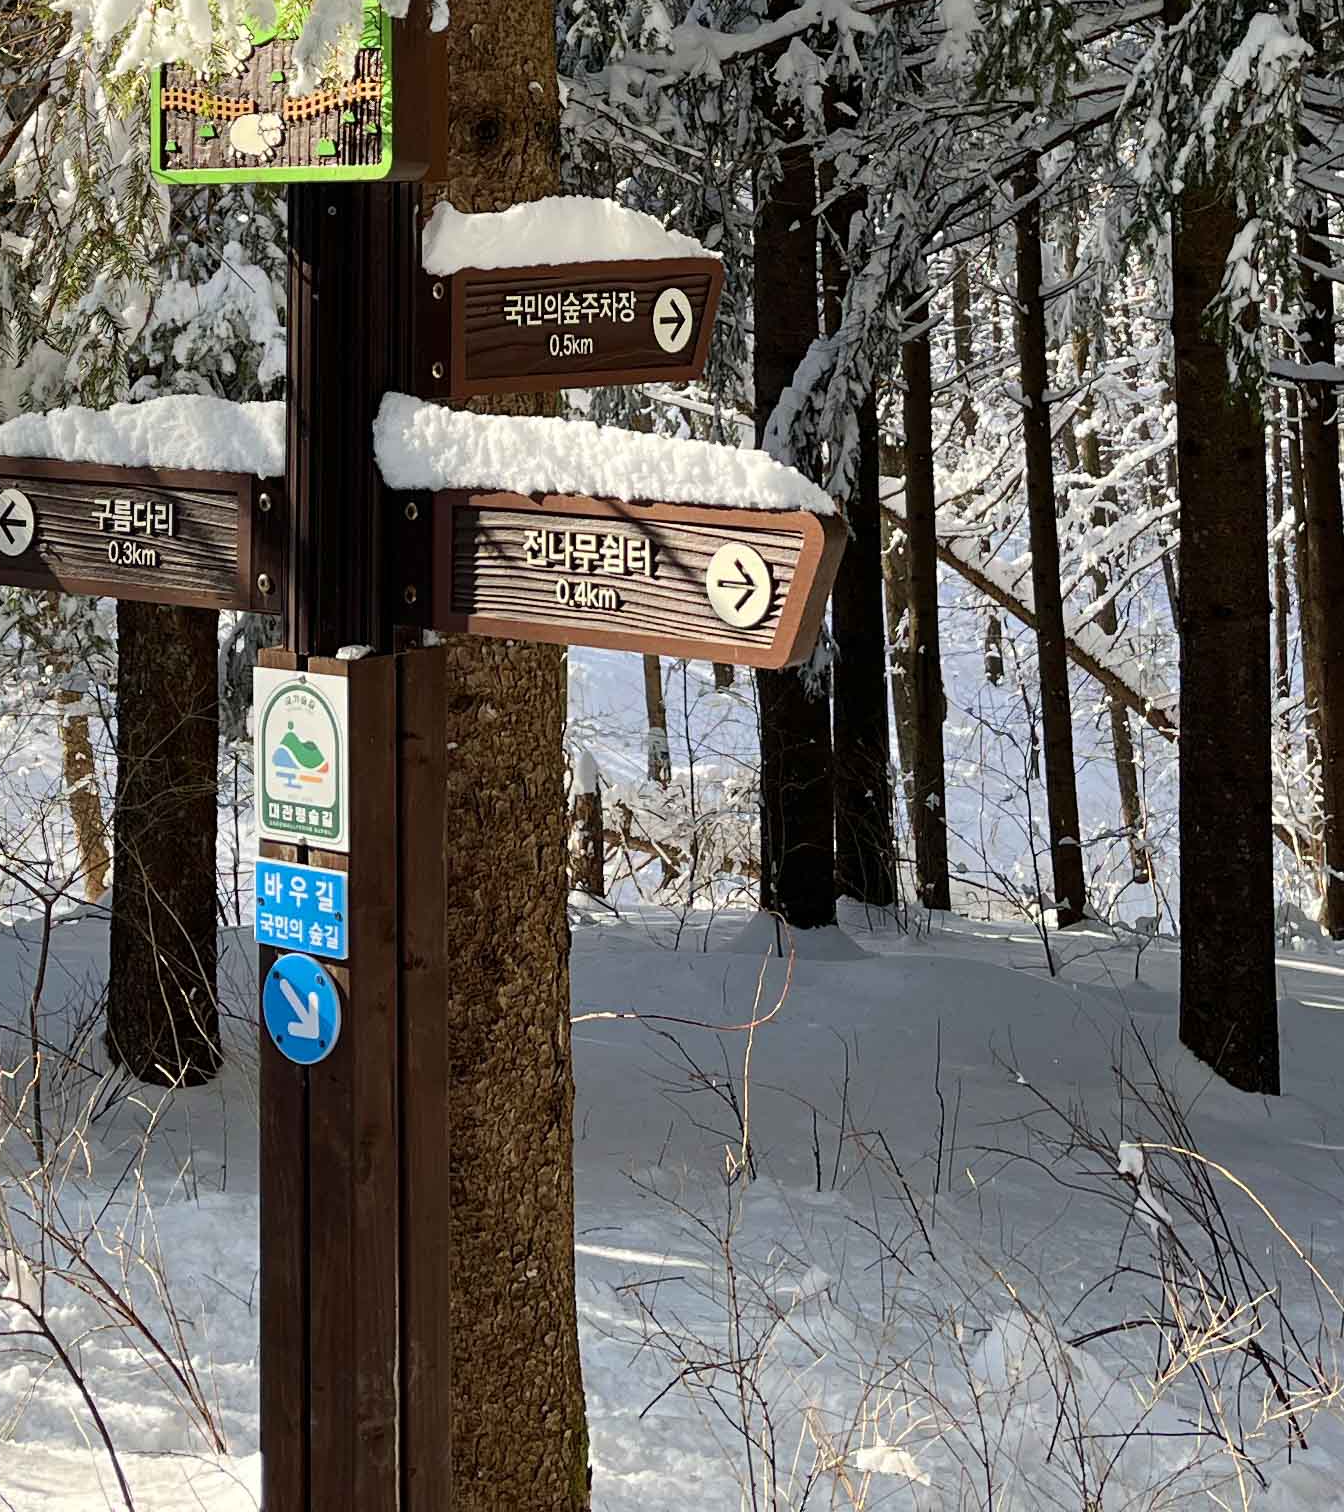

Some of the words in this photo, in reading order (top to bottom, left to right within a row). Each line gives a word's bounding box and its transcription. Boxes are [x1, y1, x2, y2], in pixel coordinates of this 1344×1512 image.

[503, 291, 637, 328] 국민의숲주차장
[549, 334, 594, 357] 0.5km
[91, 499, 173, 537] 구름다리
[108, 540, 157, 567] 0.3km
[522, 528, 652, 577] 전나무쉼터
[556, 578, 617, 609] 0.4km
[259, 911, 304, 944] 국민의
[308, 921, 339, 951] 숲길
